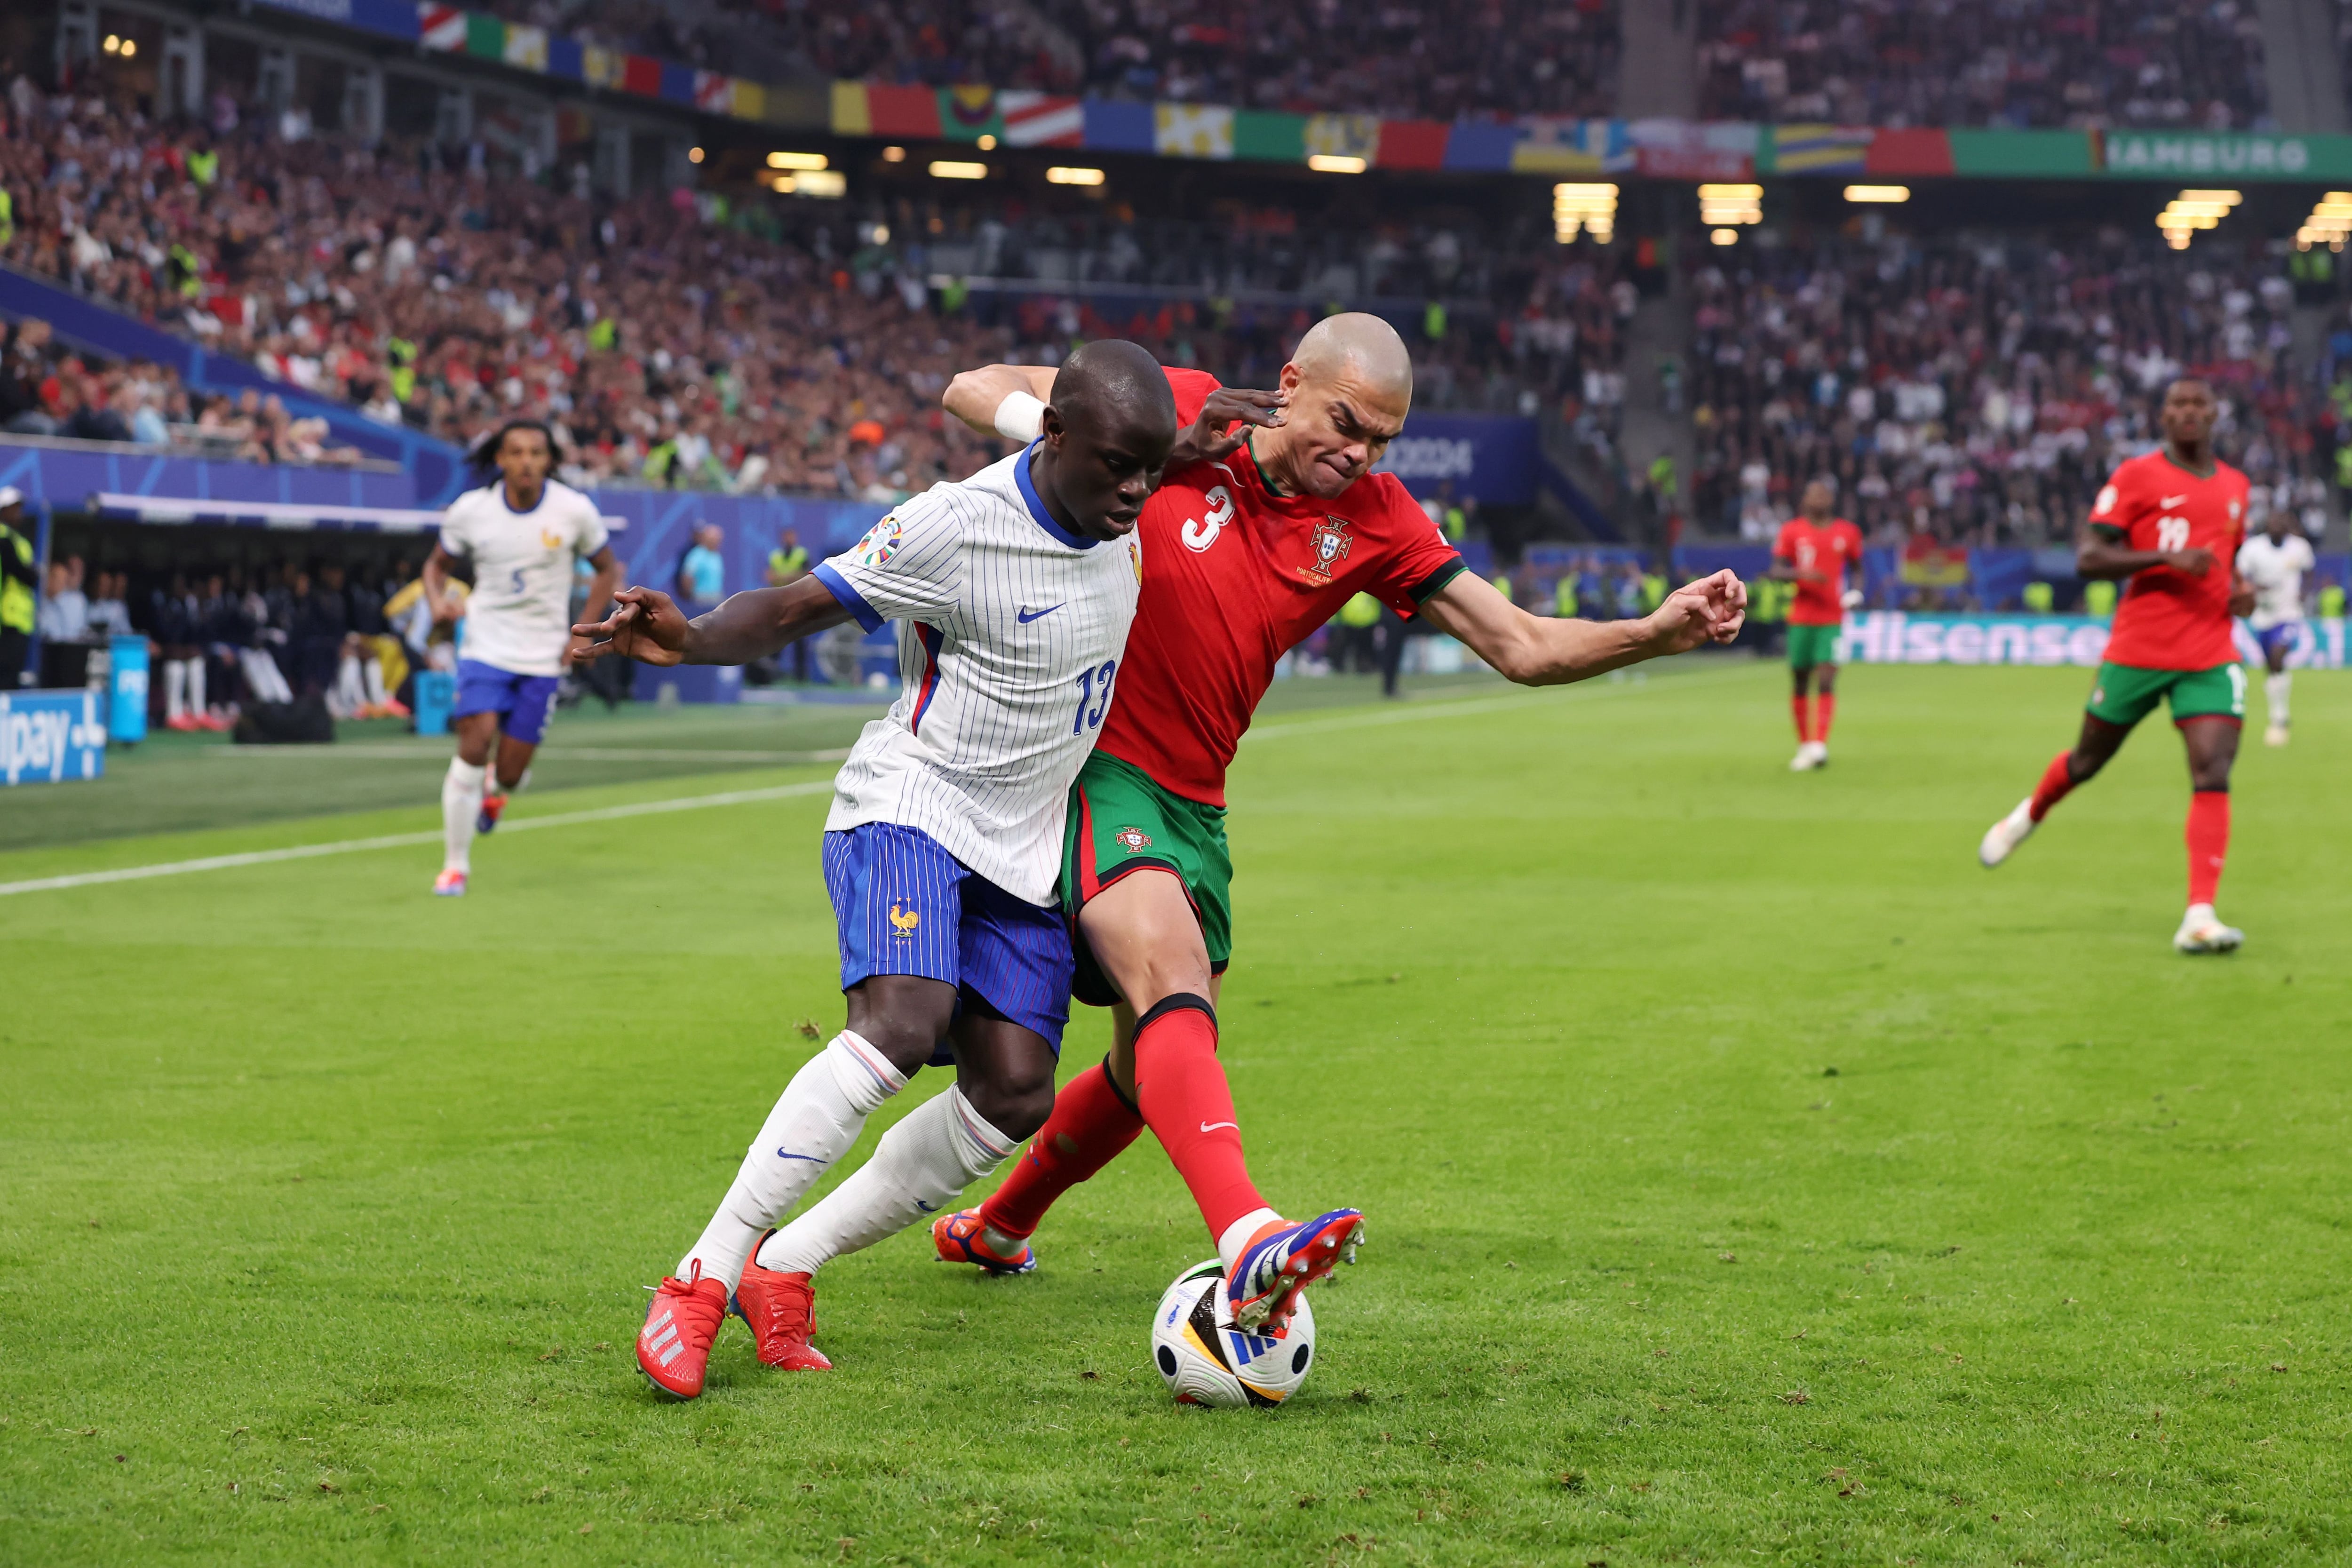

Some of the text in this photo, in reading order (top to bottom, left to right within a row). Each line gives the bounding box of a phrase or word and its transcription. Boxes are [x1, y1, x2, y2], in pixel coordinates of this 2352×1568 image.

[1181, 485, 1235, 554] 3
[2156, 516, 2190, 554] 19
[511, 567, 525, 594] 5
[1842, 610, 2109, 667] Hisense
[1073, 660, 1116, 736] 13
